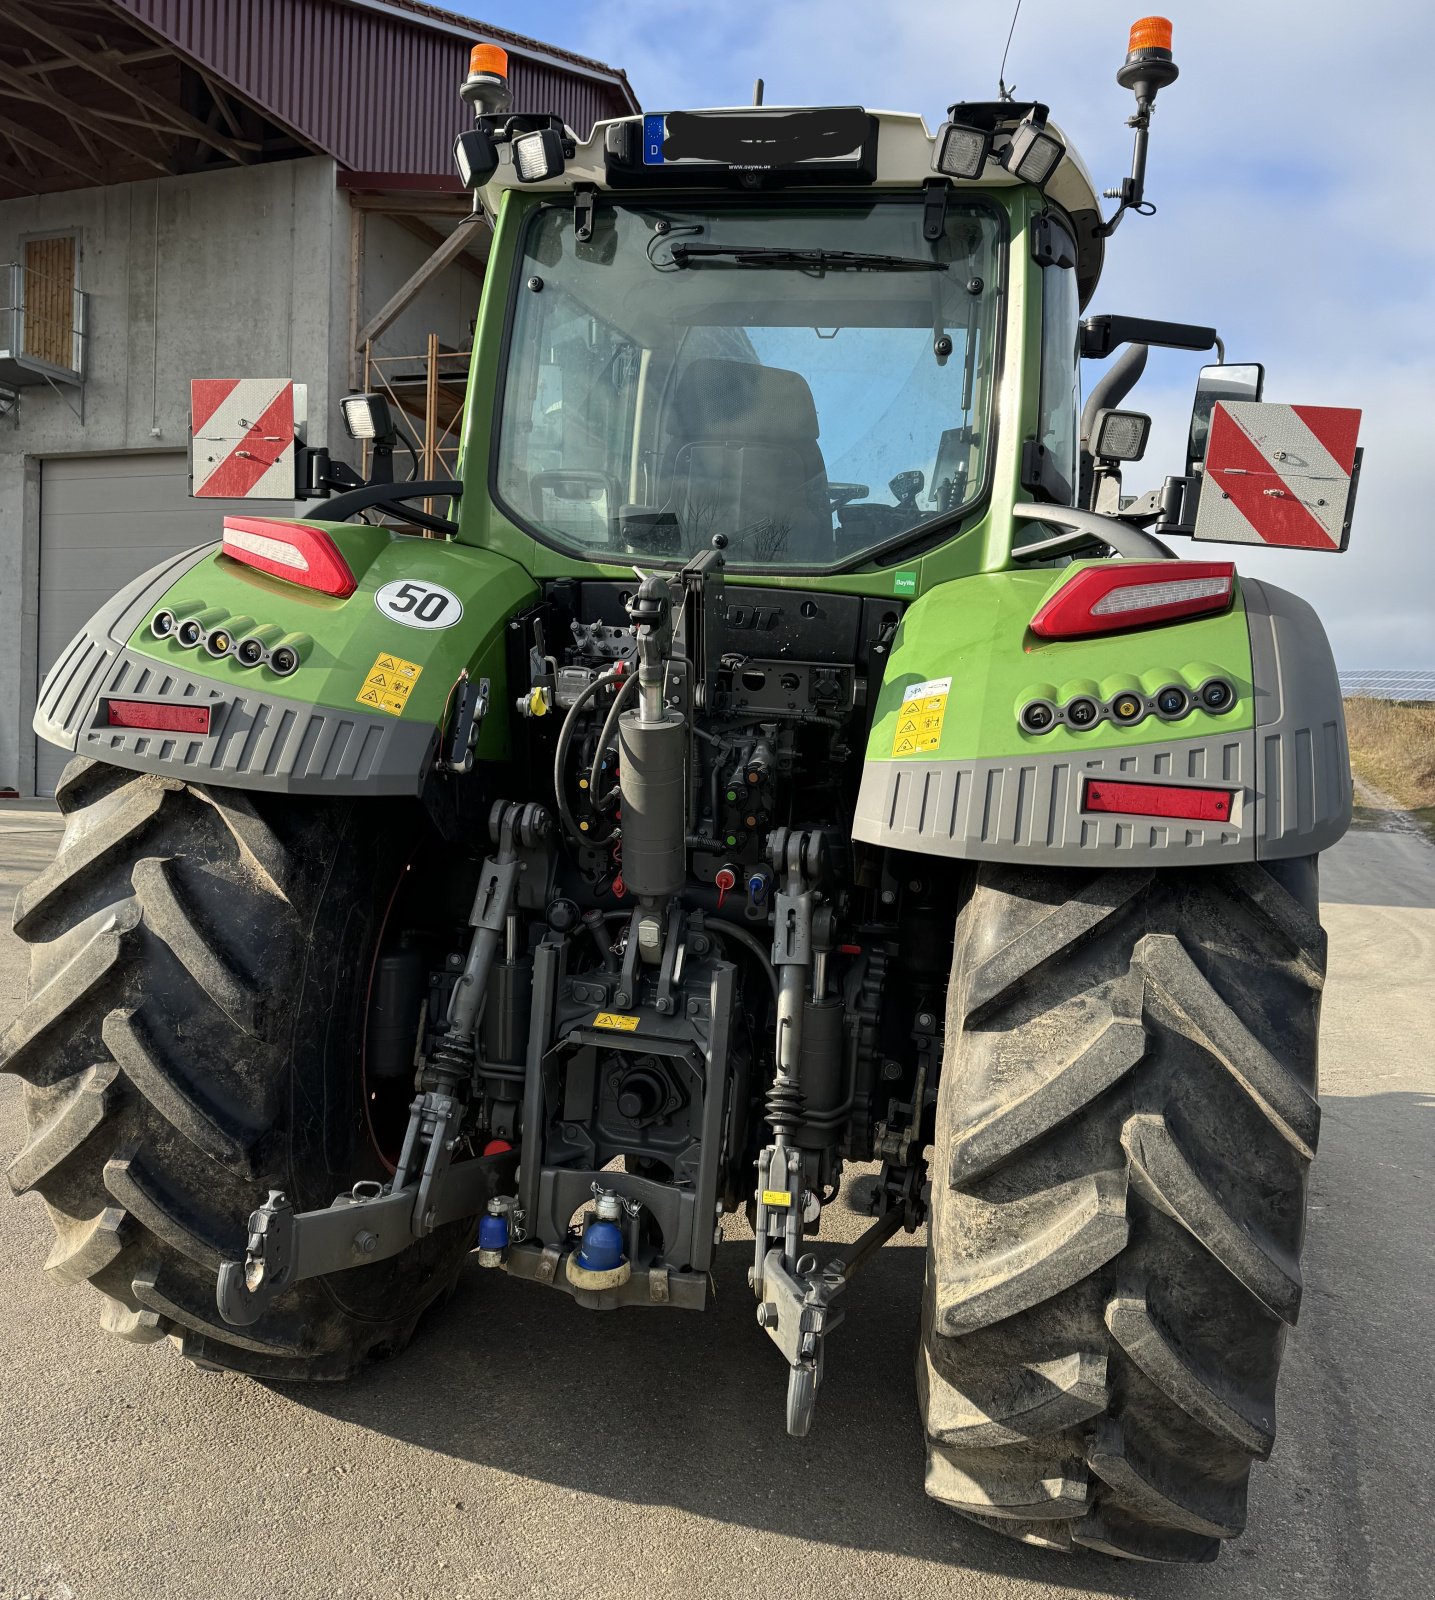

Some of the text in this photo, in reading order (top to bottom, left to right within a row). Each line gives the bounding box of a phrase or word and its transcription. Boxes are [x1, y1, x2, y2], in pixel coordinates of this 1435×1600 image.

[651, 145, 658, 155] D
[389, 584, 449, 621] 50
[727, 604, 782, 631] DT
